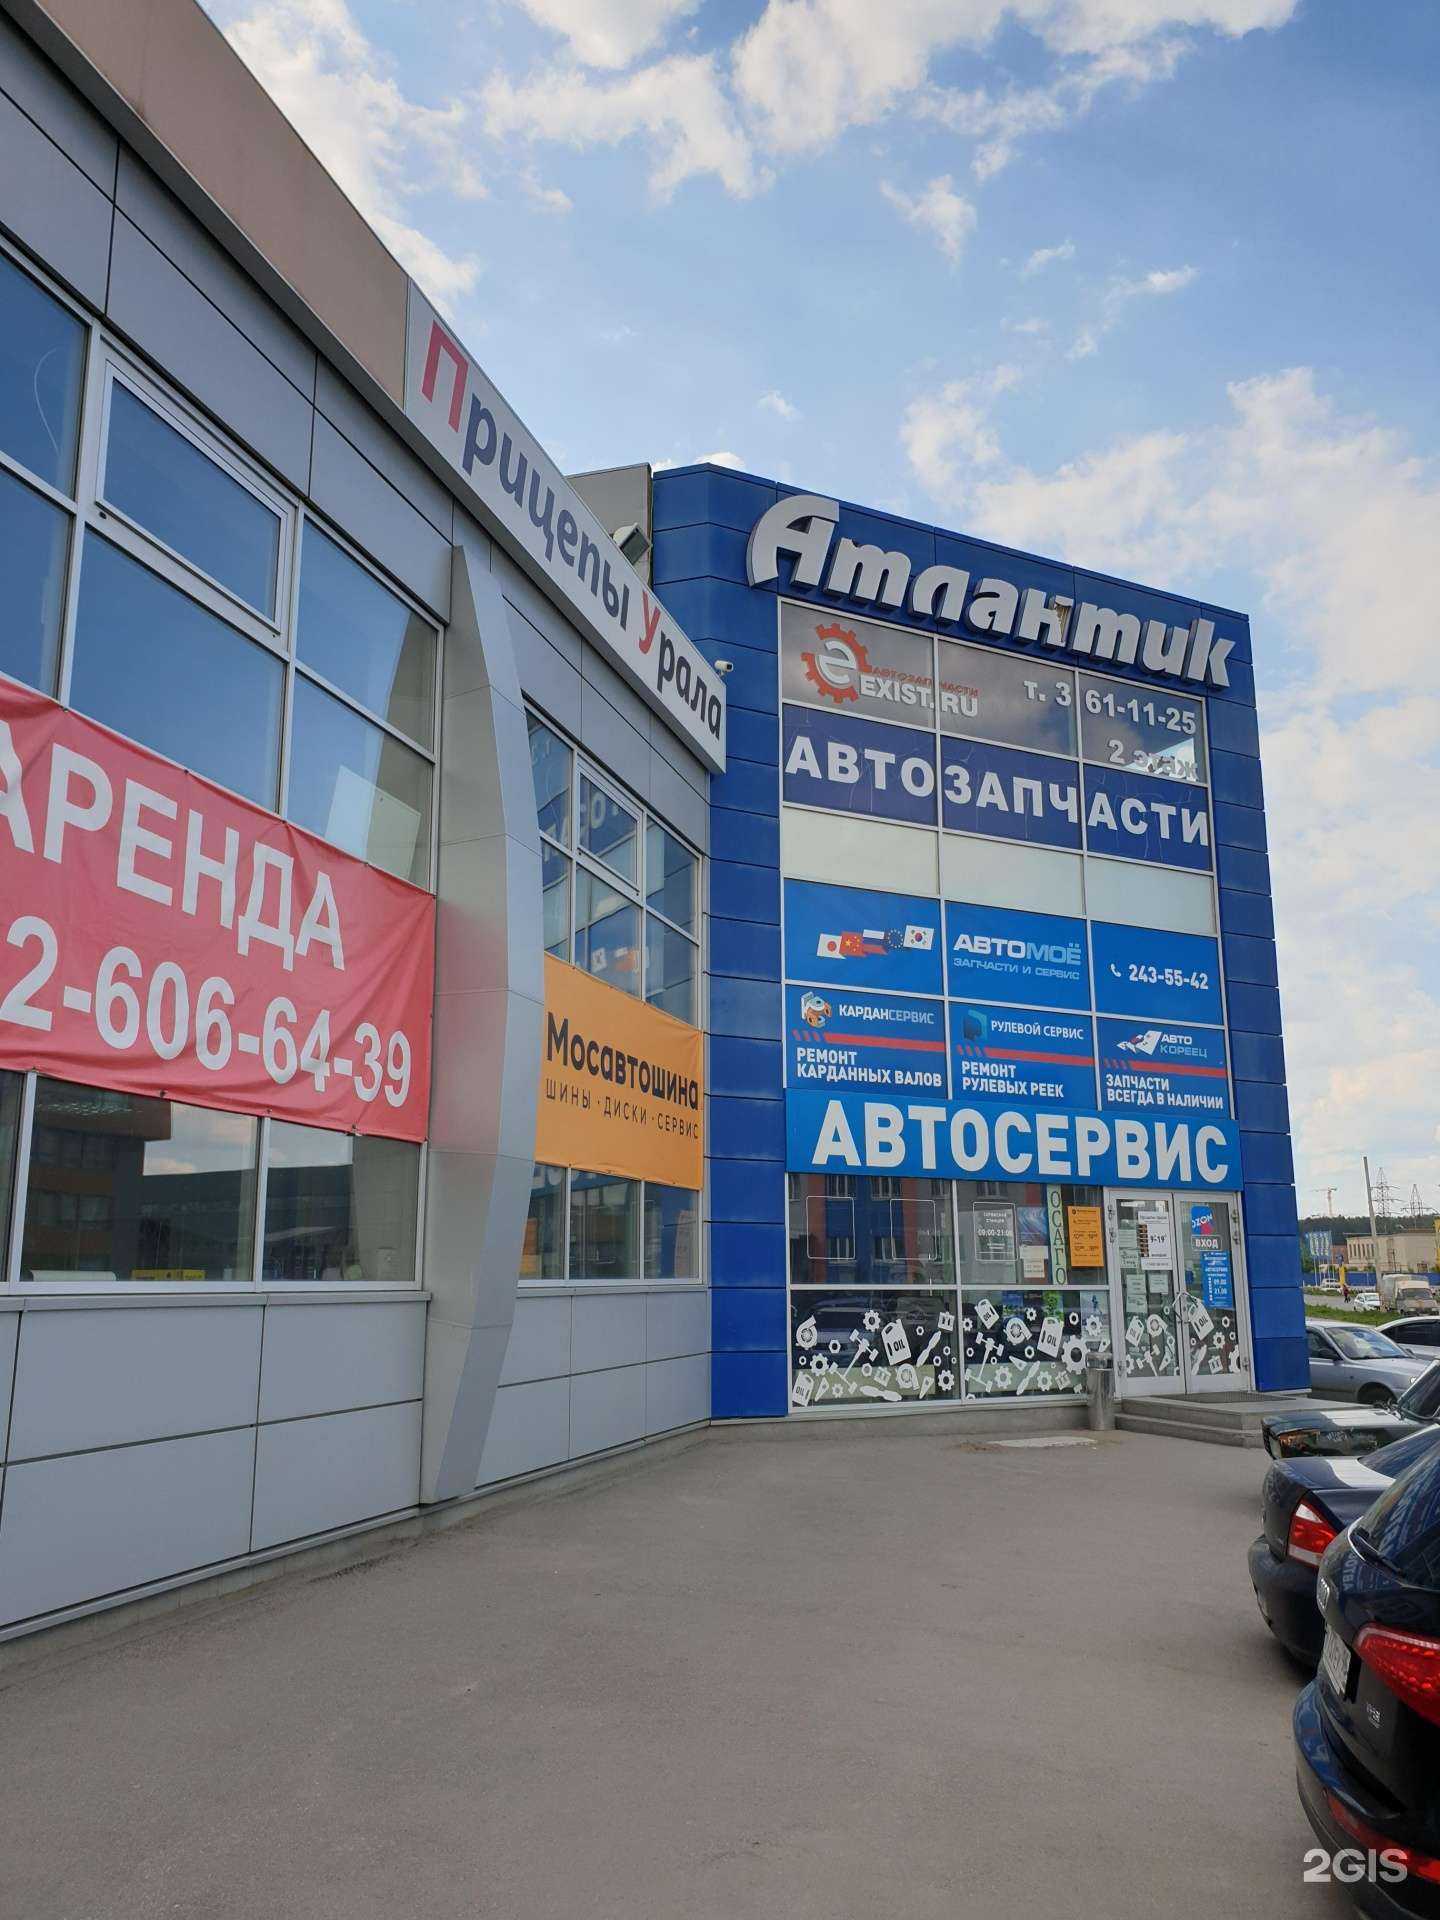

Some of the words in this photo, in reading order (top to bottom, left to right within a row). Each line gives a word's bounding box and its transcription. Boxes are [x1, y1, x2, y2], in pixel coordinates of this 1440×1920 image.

[421, 319, 630, 631] Прицепы
[639, 590, 722, 741] Урала
[746, 494, 1236, 688] Атлантик
[860, 674, 978, 718] EXIST.RU
[1108, 739, 1126, 765] 2
[784, 735, 1208, 847] АВТОЗАПЧАСТИ
[953, 934, 1082, 966] АВТОМОЁ
[953, 957, 1019, 974] ЗАПЧАСТИ
[1022, 966, 1032, 975] И
[1034, 967, 1080, 980] СЕРВИС
[1128, 963, 1209, 990] 243-55-42
[0, 915, 412, 1108] 2-606-64-39
[839, 1004, 935, 1025] КАРДАНСЕРВИС
[991, 1020, 1041, 1036] РУЛЕВОЙ
[1043, 1025, 1085, 1040] СЕРВИС
[1161, 1034, 1193, 1045] АВТО
[547, 1011, 699, 1111] Мосавтошина
[796, 1047, 858, 1065] РЕМОНТ
[1160, 1045, 1208, 1058] КОРЕЕЦ
[797, 1063, 891, 1084] КАРДАННЫХ
[894, 1070, 942, 1087] ВАЛОВ
[961, 1060, 1016, 1078] РЕМОНТ
[962, 1076, 1028, 1096] РУЛЕВЫХ
[1030, 1082, 1064, 1098] РЕЕК
[1106, 1073, 1170, 1091] ЗАПЧАСТИ
[546, 1078, 591, 1110] ШИНЫ
[604, 1096, 647, 1125] ДИСКИ
[657, 1113, 699, 1140] СЕРВИС
[1107, 1088, 1155, 1106] ВСЕГДА
[1156, 1092, 1165, 1105] В
[1167, 1093, 1224, 1110] НАЛИЧИИ
[811, 1099, 1229, 1184] АВТОСЕРВИС
[1051, 1191, 1067, 1285] ОСАГО
[1195, 1238, 1219, 1250] ВХОД
[894, 1341, 906, 1352] OIL
[1047, 1335, 1057, 1347] OIL
